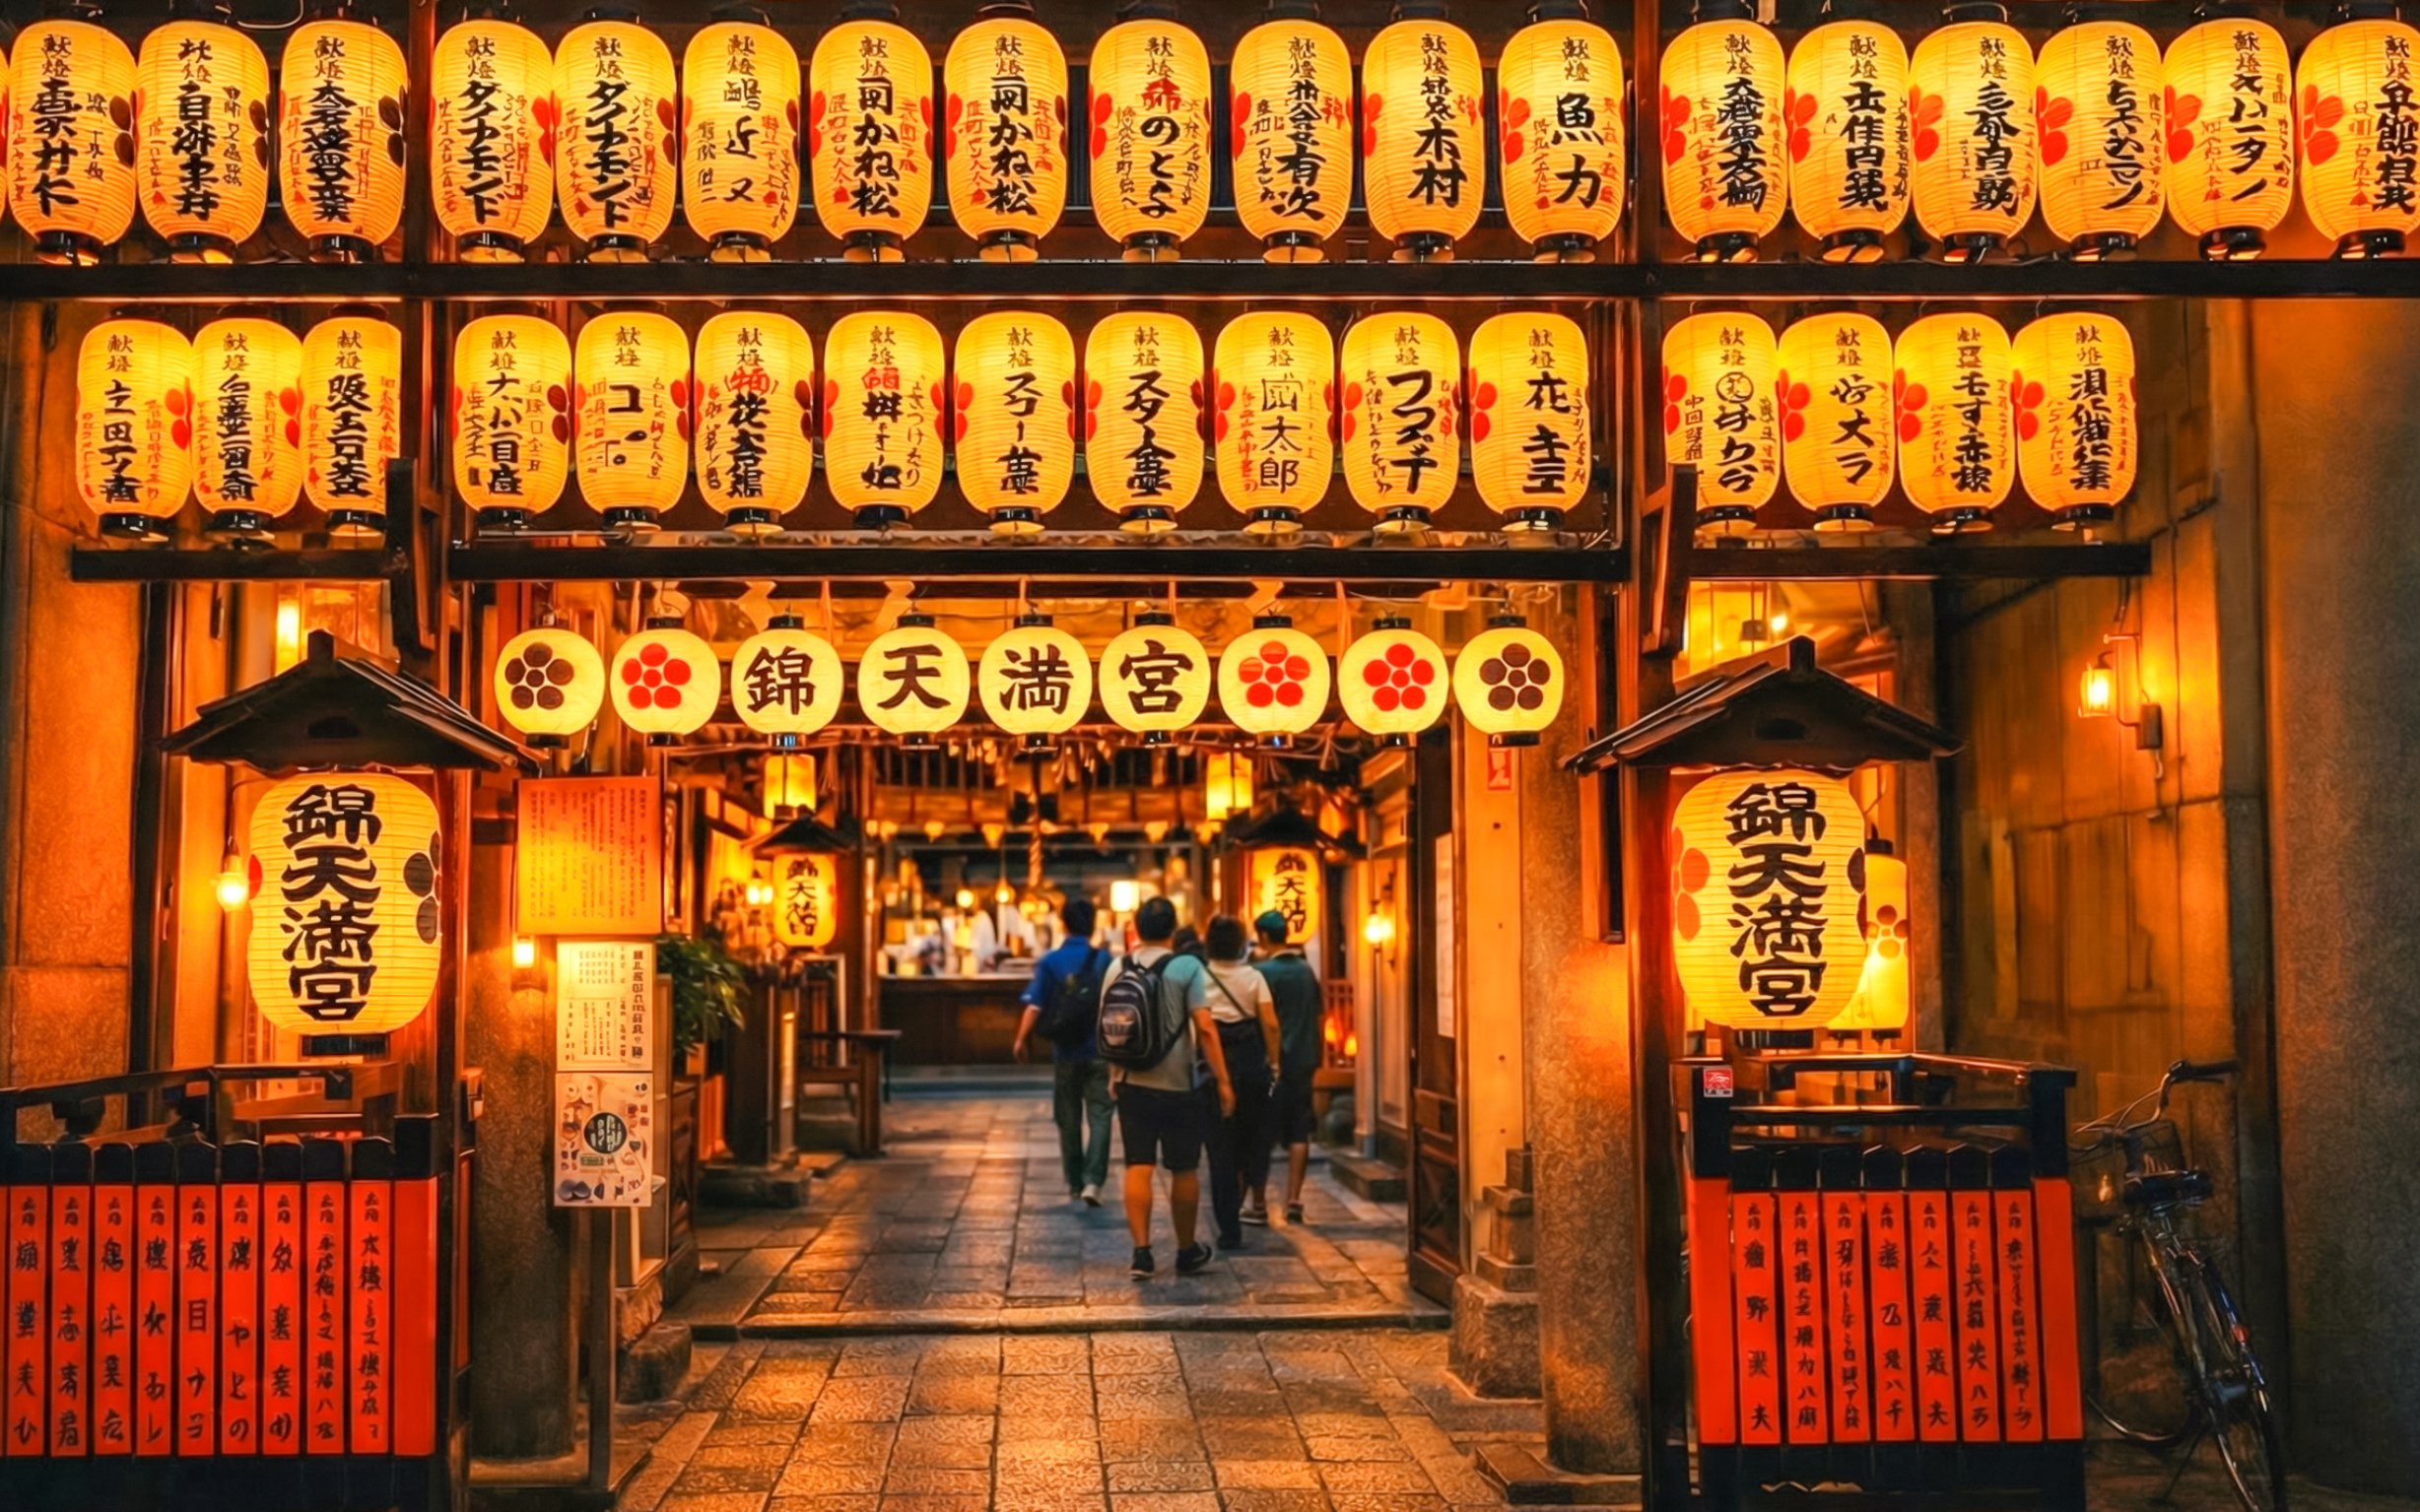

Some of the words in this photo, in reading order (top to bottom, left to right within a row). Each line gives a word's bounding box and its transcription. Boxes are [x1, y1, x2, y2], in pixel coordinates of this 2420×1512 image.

[1408, 118, 1468, 208] 木村
[1550, 92, 1606, 210] 魚力
[281, 784, 382, 1020] 錦天満宮
[1724, 782, 1829, 1017] 錦天満宮
